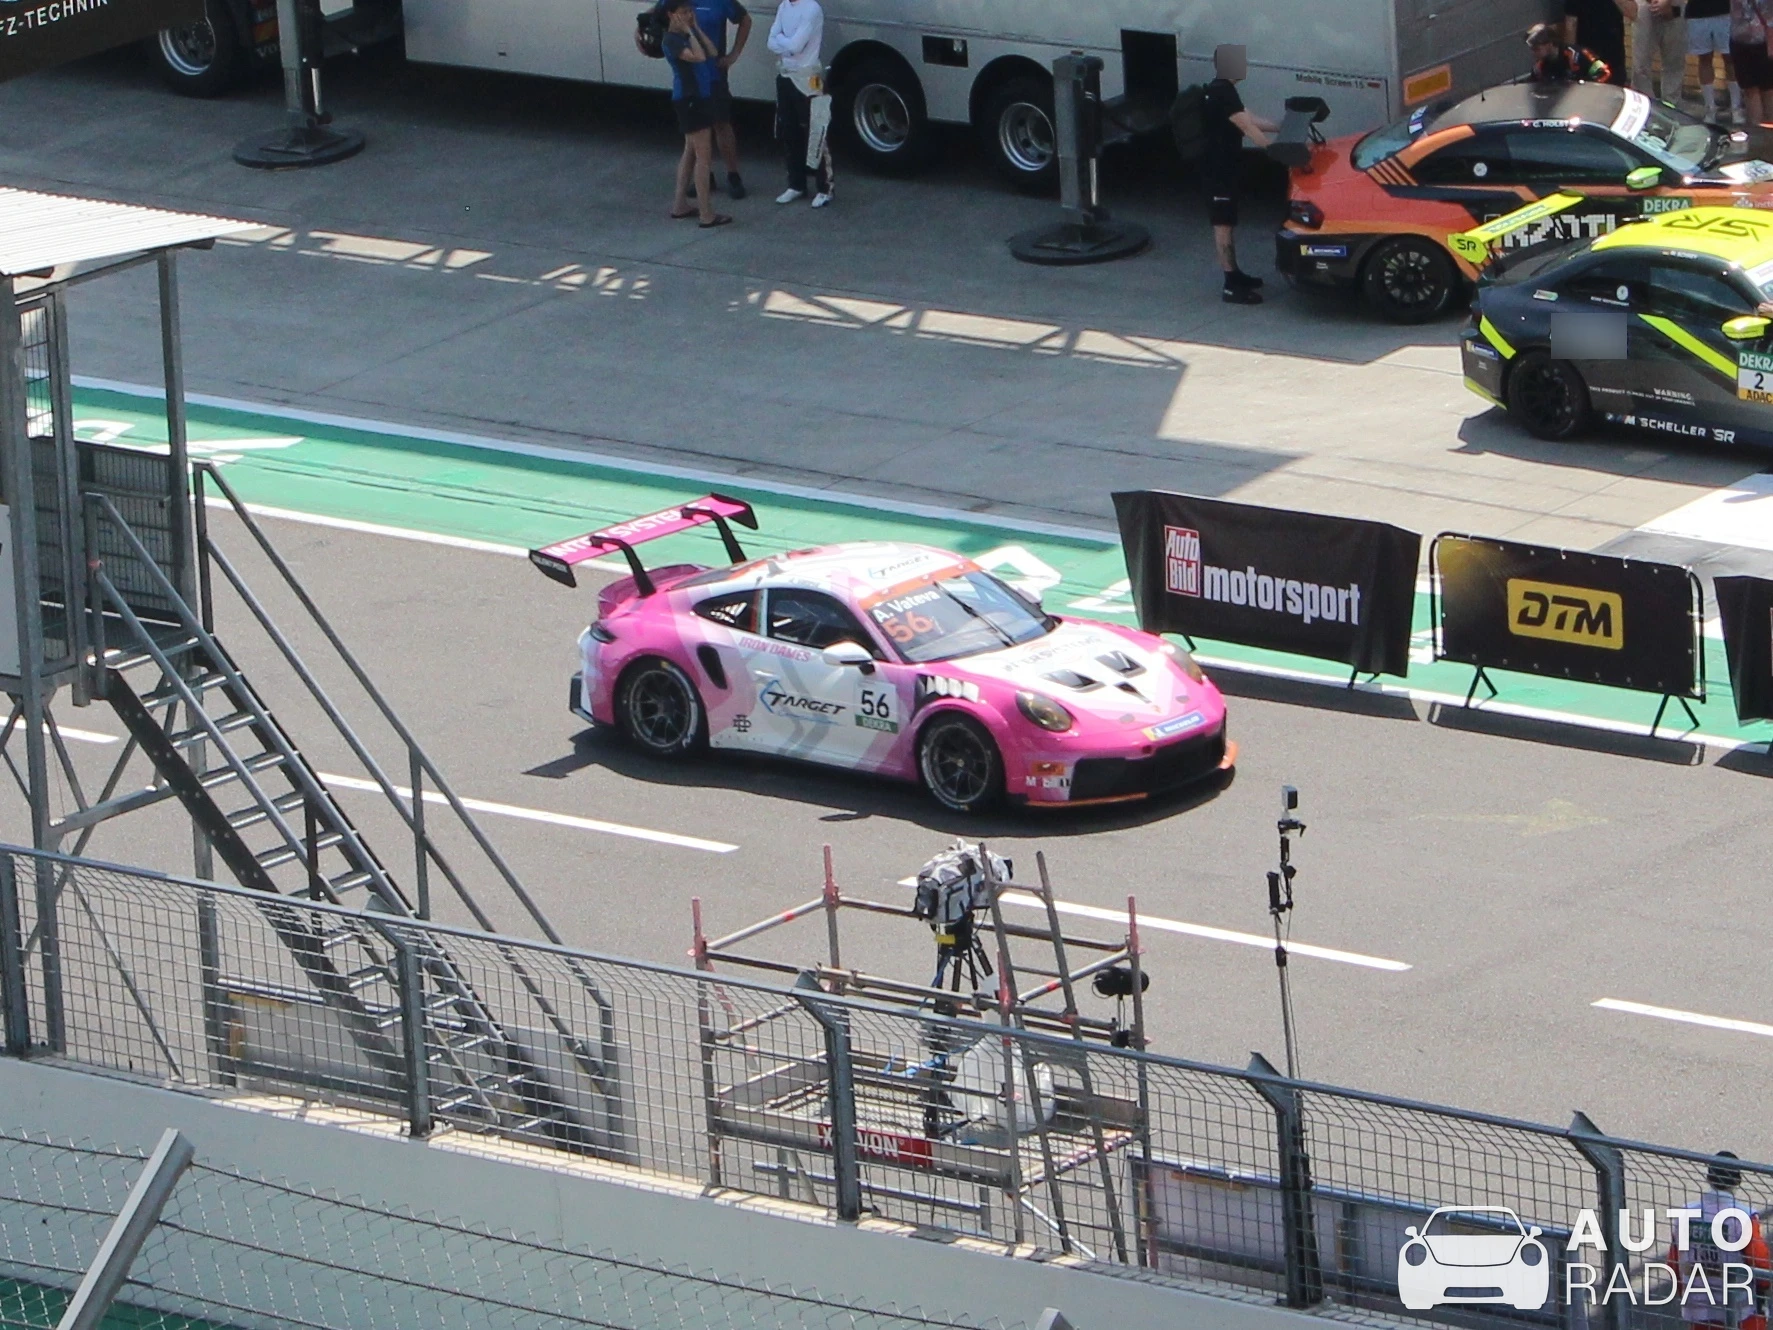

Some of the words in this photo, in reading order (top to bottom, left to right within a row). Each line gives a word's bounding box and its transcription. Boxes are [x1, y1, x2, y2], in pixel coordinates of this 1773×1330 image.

[1643, 199, 1690, 213] DEKRA
[1457, 238, 1477, 251] SR
[1754, 372, 1765, 391] 2
[1639, 417, 1706, 438] SCHELLER
[1166, 530, 1200, 560] Auto
[1168, 558, 1198, 593] Bild
[1203, 565, 1361, 626] motorsport
[882, 611, 934, 643] 56
[1516, 591, 1613, 638] DTM
[739, 636, 770, 653] IRON
[769, 643, 812, 663] DAMES
[767, 691, 847, 716] TARGET
[860, 689, 890, 719] 56
[823, 1125, 899, 1158] XVON
